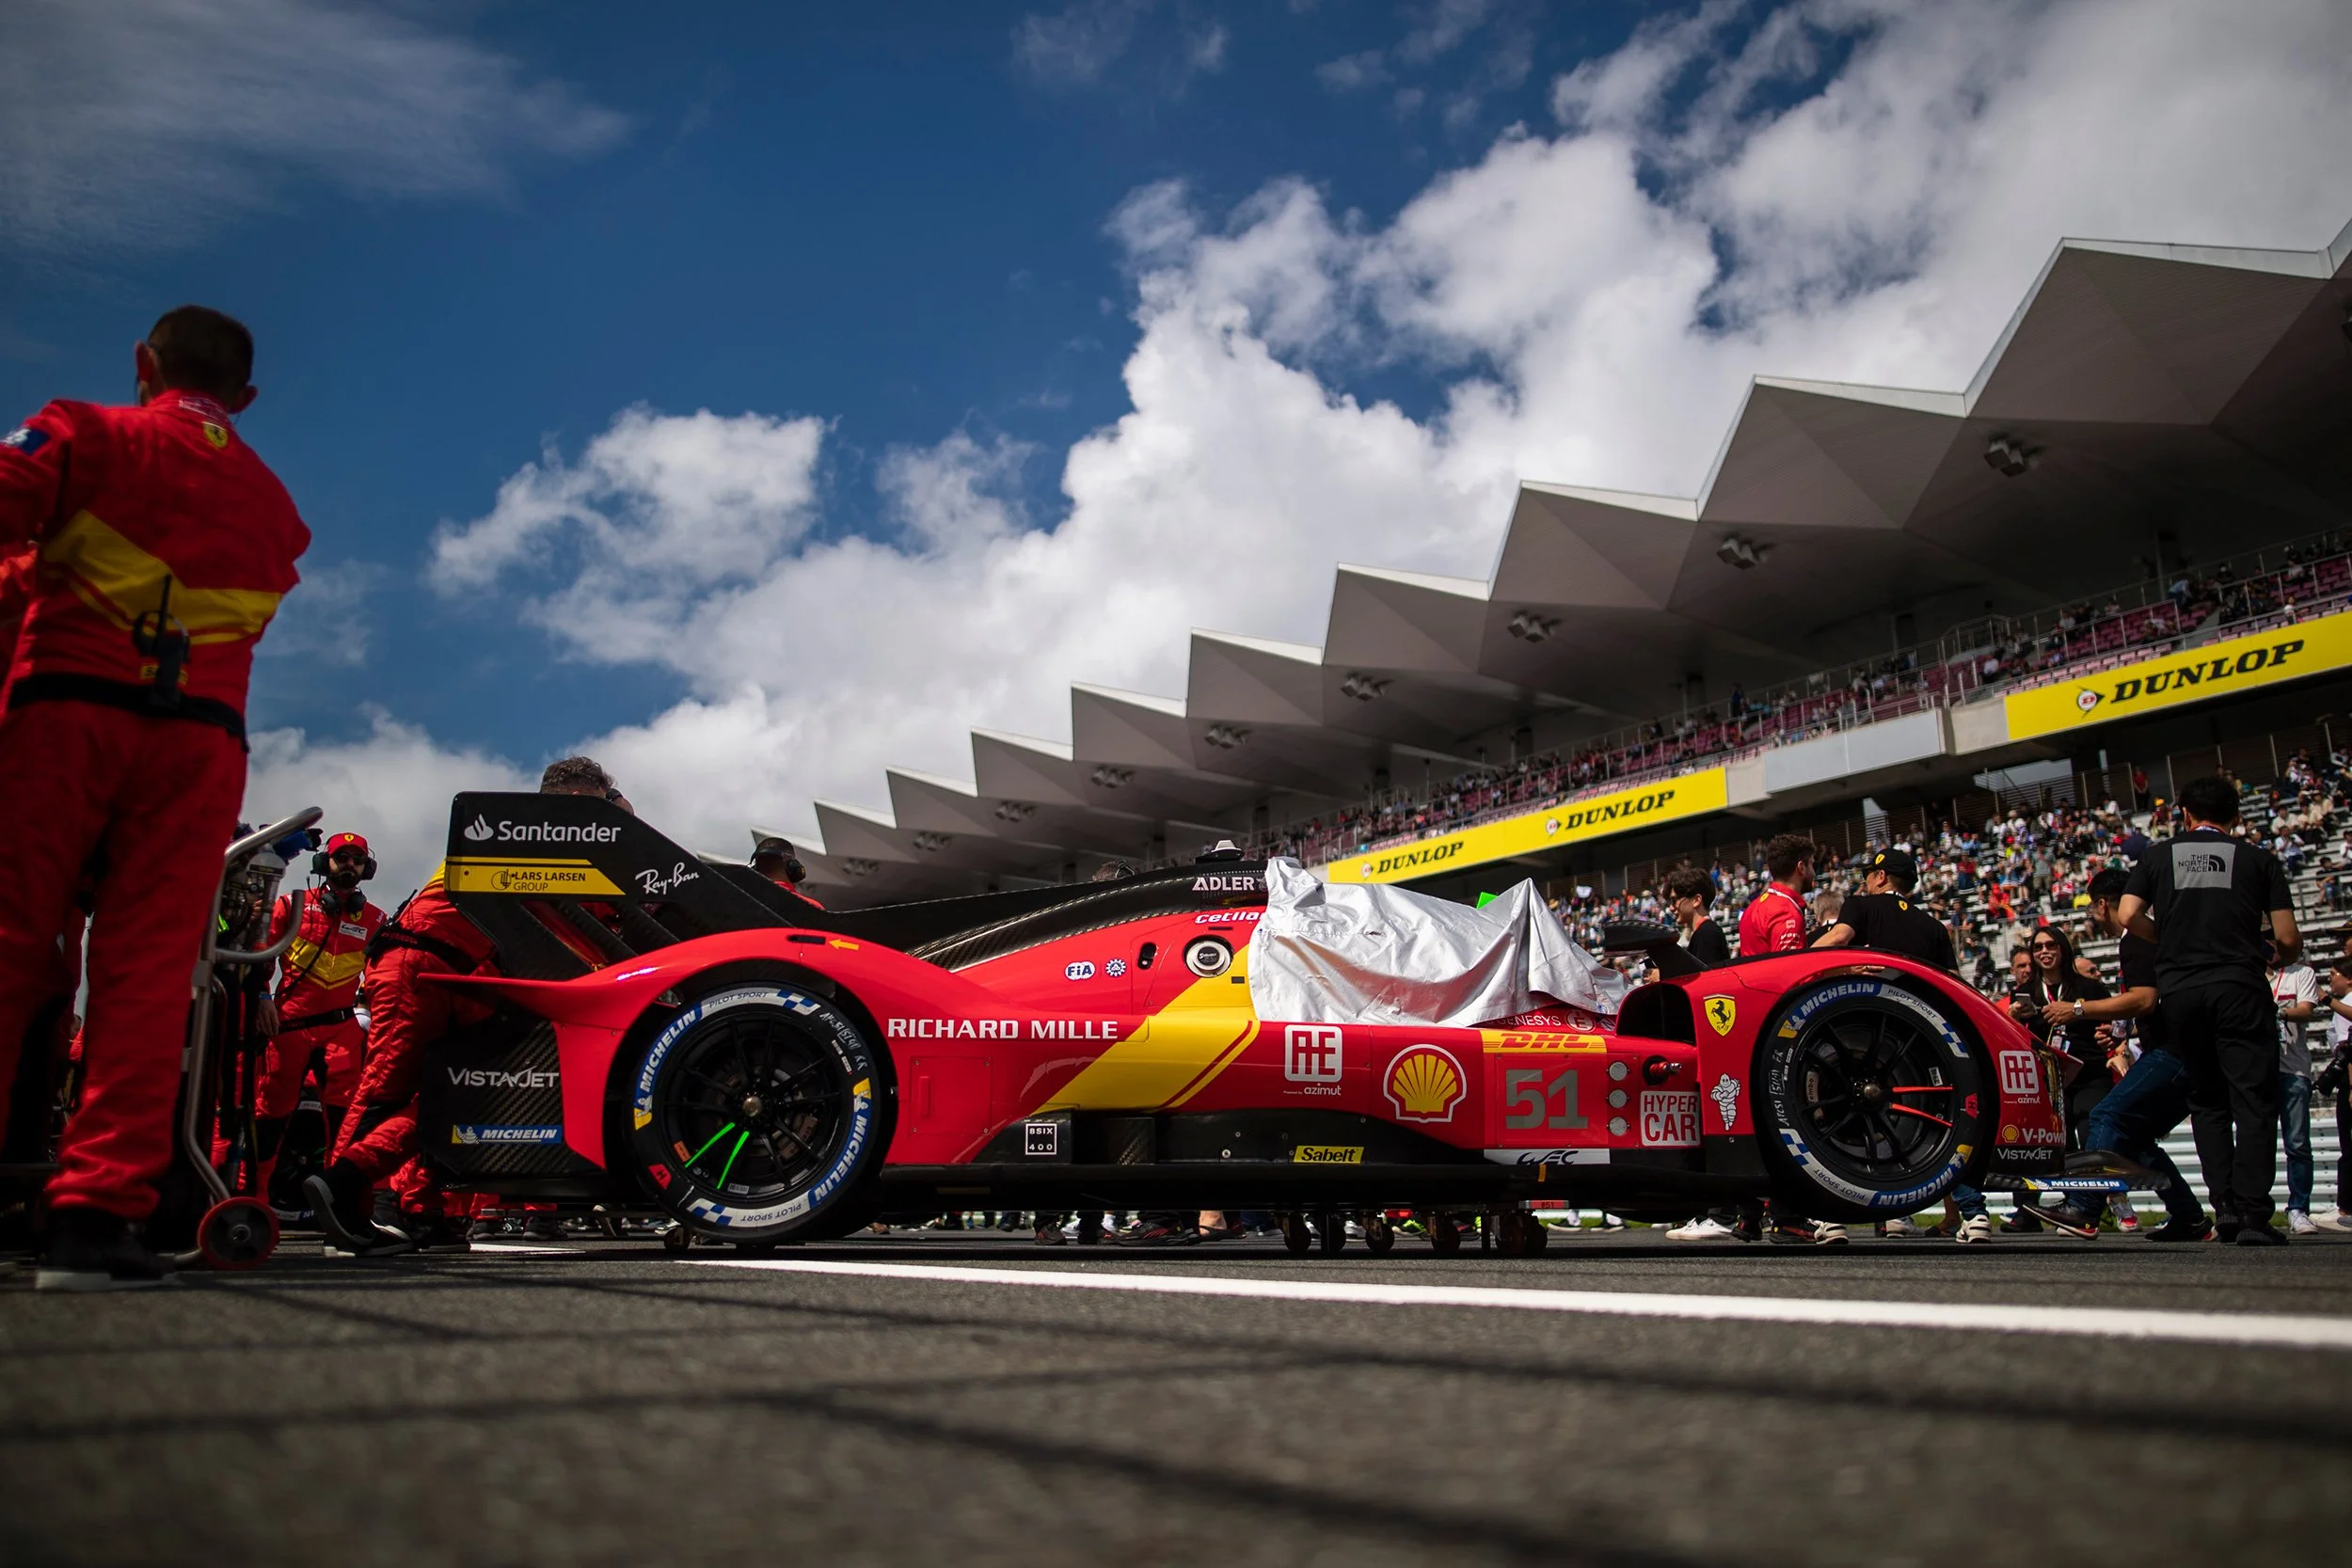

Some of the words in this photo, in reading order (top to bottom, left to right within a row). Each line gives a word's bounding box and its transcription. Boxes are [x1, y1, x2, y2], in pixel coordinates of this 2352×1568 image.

[2110, 640, 2304, 704] DUNLOP
[1565, 790, 1675, 830] DUNLOP
[498, 820, 621, 843] Santander
[1377, 841, 1464, 874] DUNLOP
[515, 870, 543, 880] LARS
[544, 871, 586, 881] LARSEN
[1192, 876, 1255, 892] ADLER
[514, 881, 548, 892] GROUP
[708, 994, 735, 1007] PILOT
[737, 991, 768, 1000] SPORT
[1801, 983, 1875, 1017] MICHELIN
[1887, 989, 1912, 1002] PILOT
[1911, 999, 1938, 1019] SPORT
[888, 1019, 1019, 1038] RICHARD
[1031, 1021, 1118, 1039] MILLE
[1497, 1015, 1562, 1026] GENESYS
[1501, 1033, 1591, 1049] DHL
[640, 1010, 696, 1092] MICHELIN
[447, 1066, 560, 1087] VISTAJET
[1304, 1083, 1342, 1096] azimut
[1505, 1069, 1588, 1129] 51
[1644, 1095, 1698, 1113] HYPER
[2017, 1094, 2041, 1104] azimut
[481, 1129, 557, 1139] MICHELIN
[1644, 1114, 1697, 1142] CAR
[814, 1115, 867, 1201] MICHELIN
[1301, 1147, 1356, 1162] Sabelt
[1517, 1150, 1579, 1165] WEC
[1997, 1147, 2053, 1160] VISTAJET
[1813, 1168, 1840, 1189] SPORT
[1878, 1167, 1954, 1206] MICHELIN
[1839, 1186, 1866, 1200] PILOT
[740, 1212, 772, 1222] SPORT
[775, 1203, 802, 1218] PILOT
